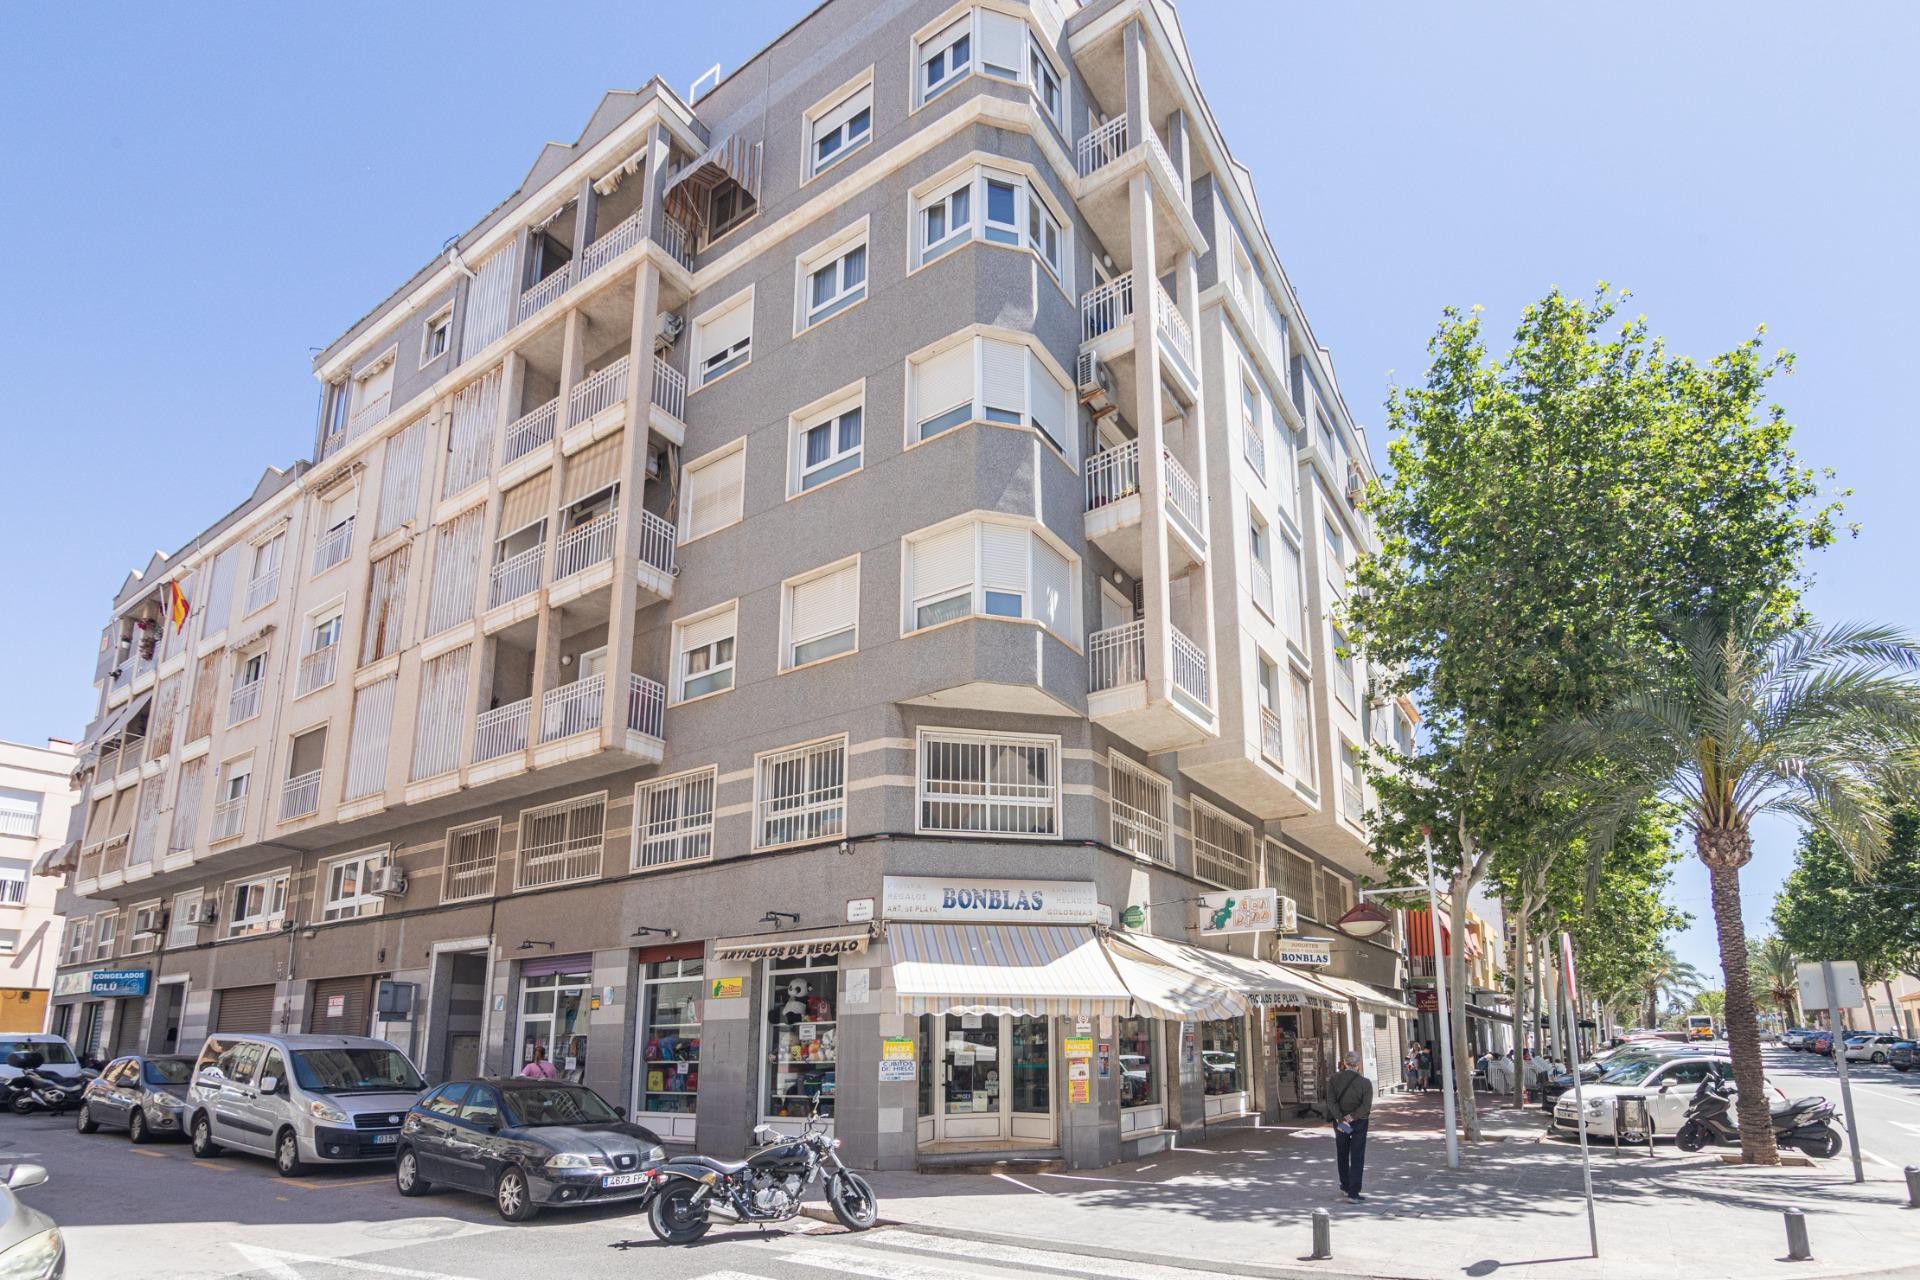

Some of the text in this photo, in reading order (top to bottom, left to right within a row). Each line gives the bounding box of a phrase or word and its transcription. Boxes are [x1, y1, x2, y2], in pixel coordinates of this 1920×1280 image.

[942, 887, 1043, 911] BONBLAS
[787, 944, 804, 956] DE
[806, 940, 859, 955] REGALO
[1281, 953, 1329, 963] BONBLAS
[93, 972, 145, 980] CONGELADOS
[92, 981, 118, 992] IGLÚ
[610, 1175, 631, 1185] 4673
